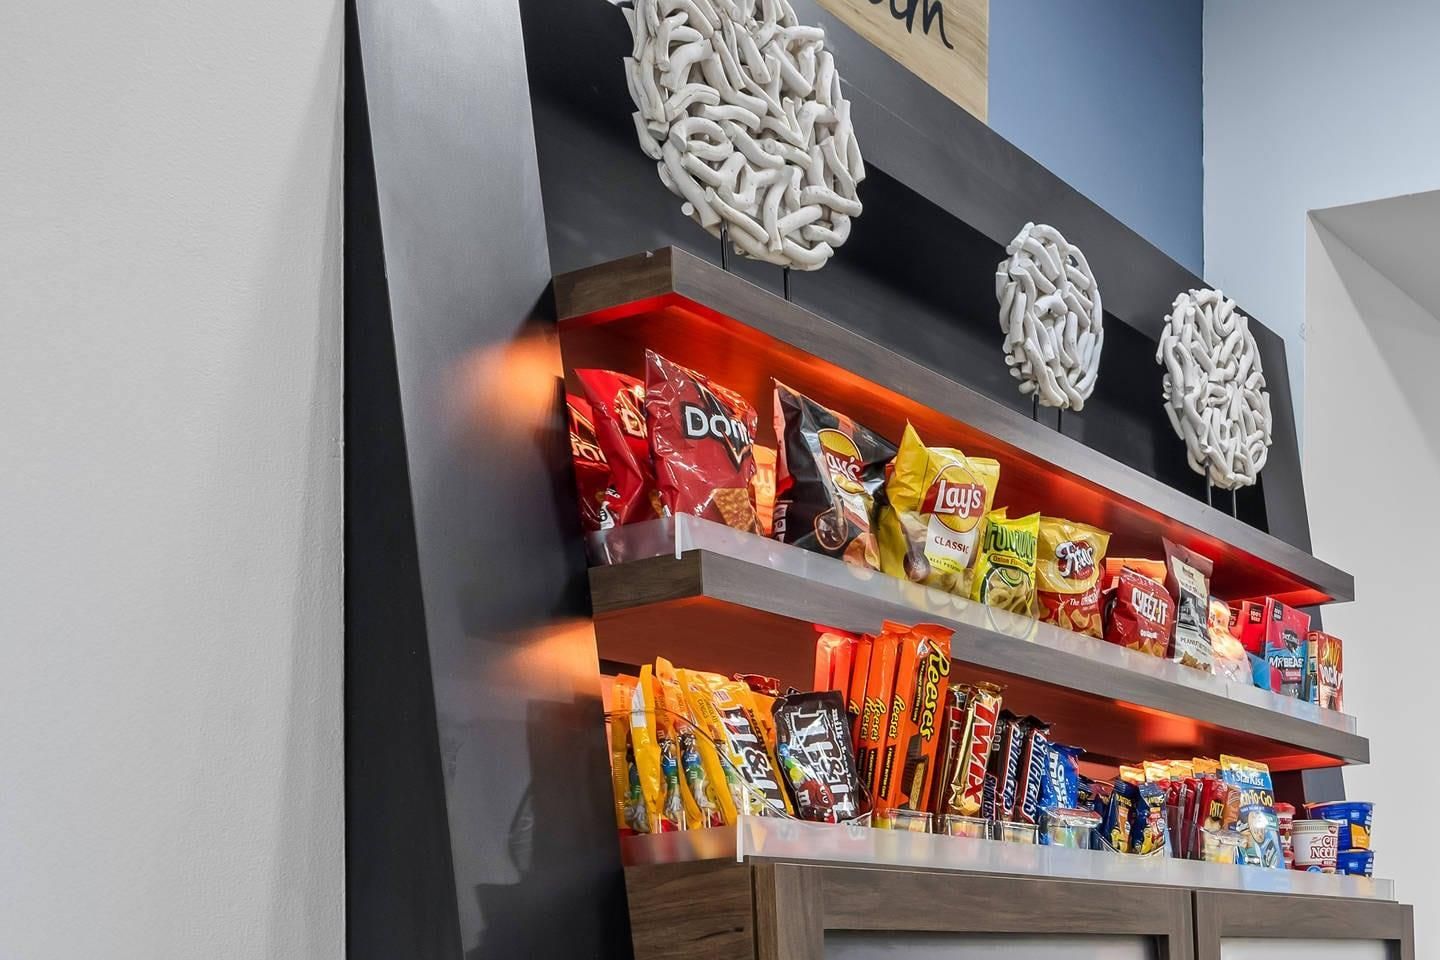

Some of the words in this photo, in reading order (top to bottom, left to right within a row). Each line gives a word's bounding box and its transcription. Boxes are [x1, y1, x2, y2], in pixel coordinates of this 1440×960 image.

[825, 451, 861, 482] ay's
[933, 479, 981, 518] Lay's
[934, 535, 971, 554] CLASSIC
[919, 638, 950, 743] Reese's
[1210, 800, 1225, 818] RITZ
